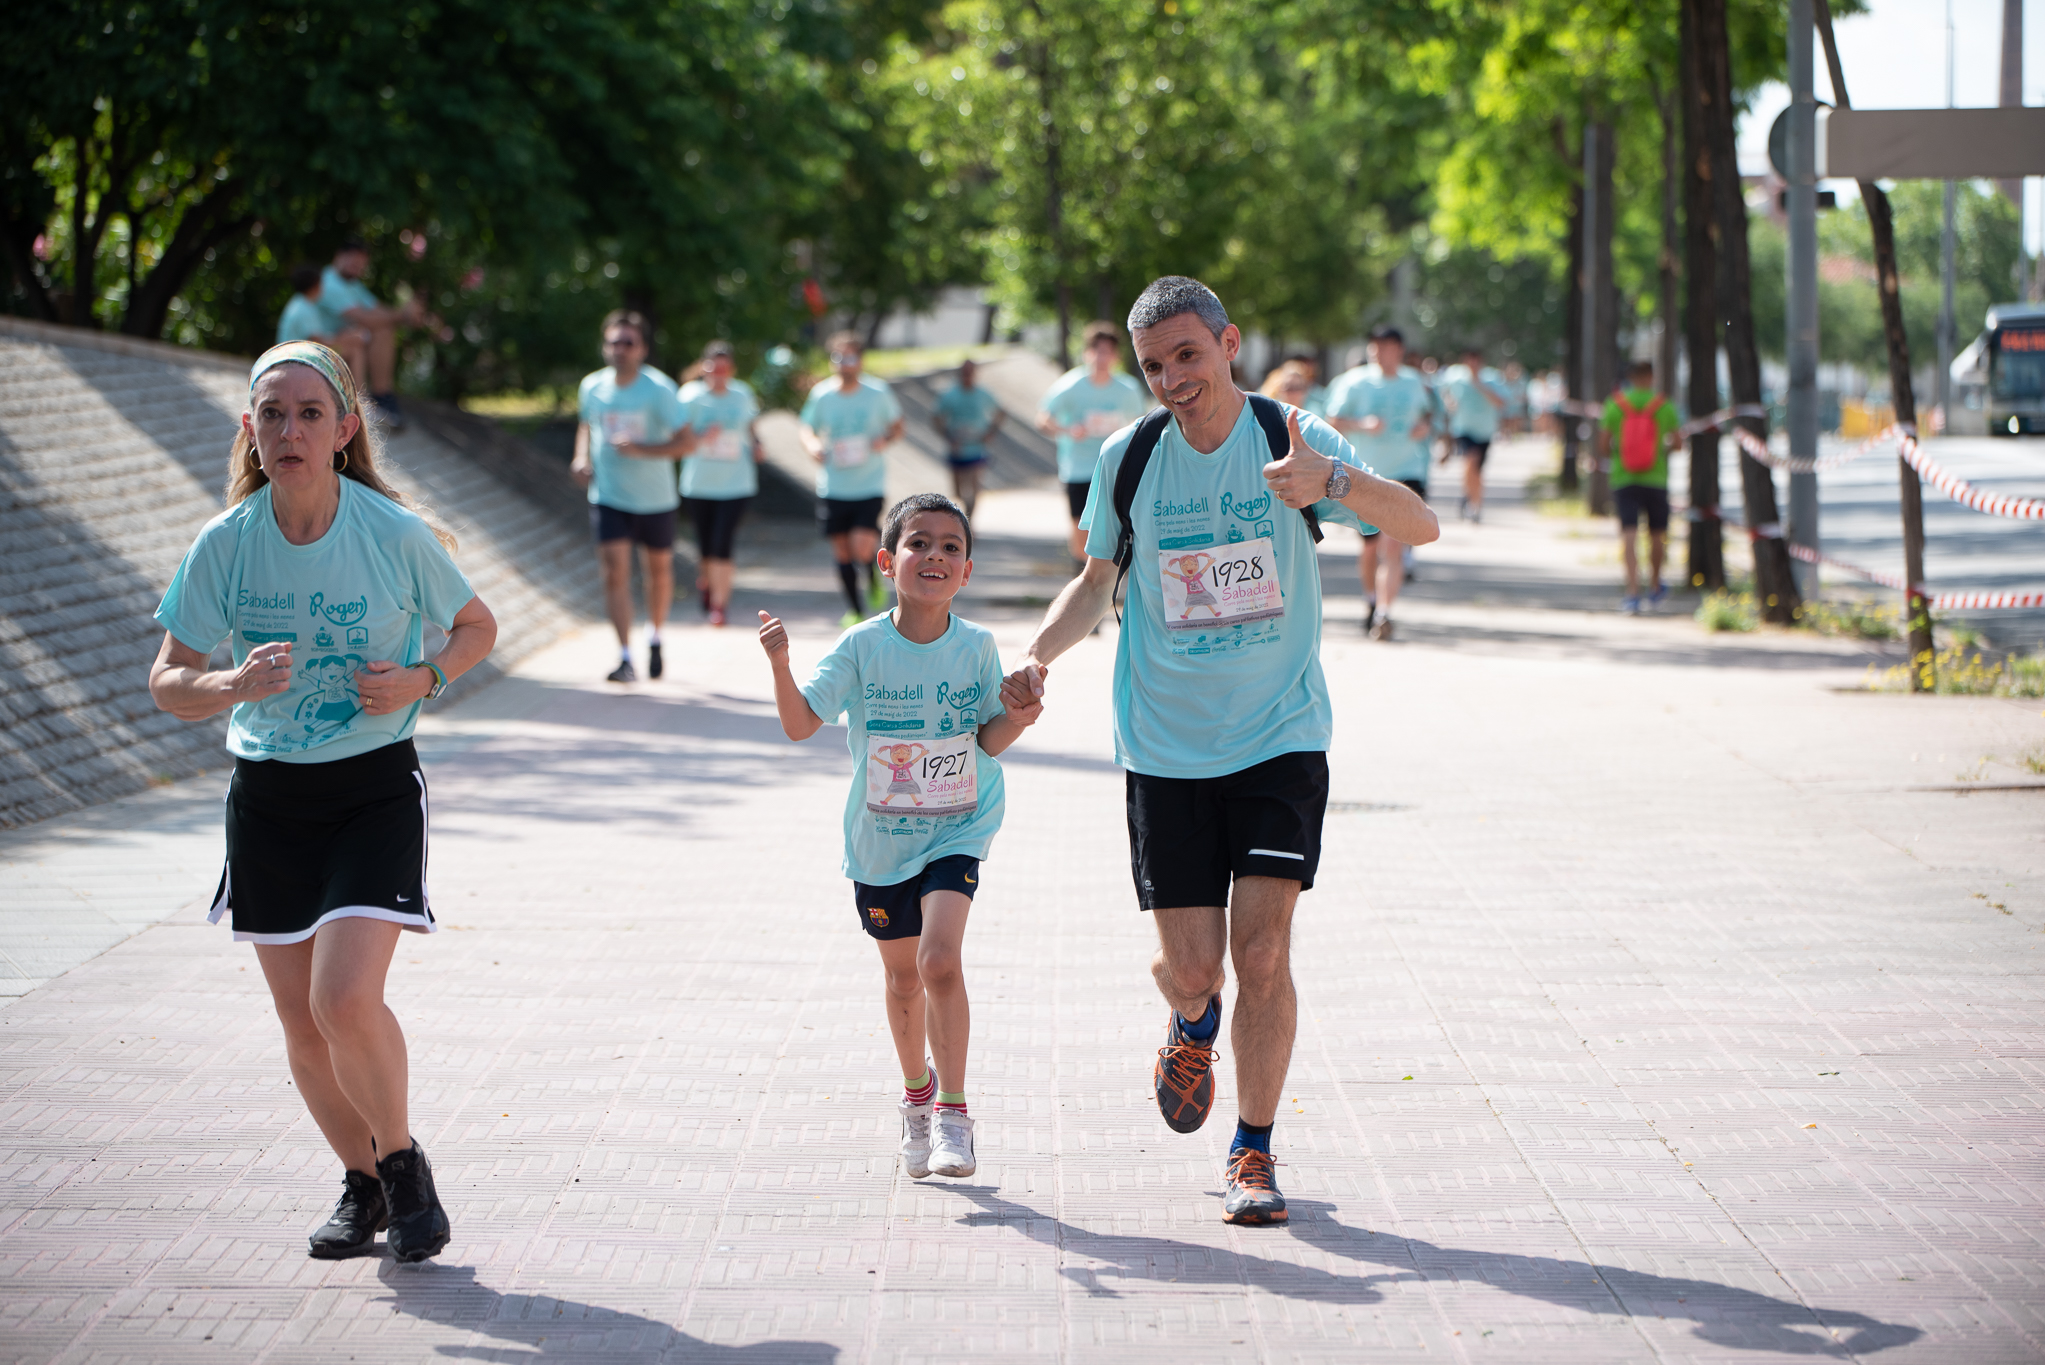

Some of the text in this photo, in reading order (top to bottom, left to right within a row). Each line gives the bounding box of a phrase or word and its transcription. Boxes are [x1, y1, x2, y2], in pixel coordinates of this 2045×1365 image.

[1152, 497, 1209, 517] Sabadell
[1191, 524, 1206, 532] 2022
[1212, 556, 1264, 587] 1928
[237, 589, 295, 610] Sabadell
[1222, 580, 1275, 601] Sabadell
[273, 621, 289, 630] 2022
[864, 682, 923, 701] Sabadell
[903, 710, 918, 718] 2022
[922, 750, 968, 780] 1927
[926, 774, 973, 793] Sabadell
